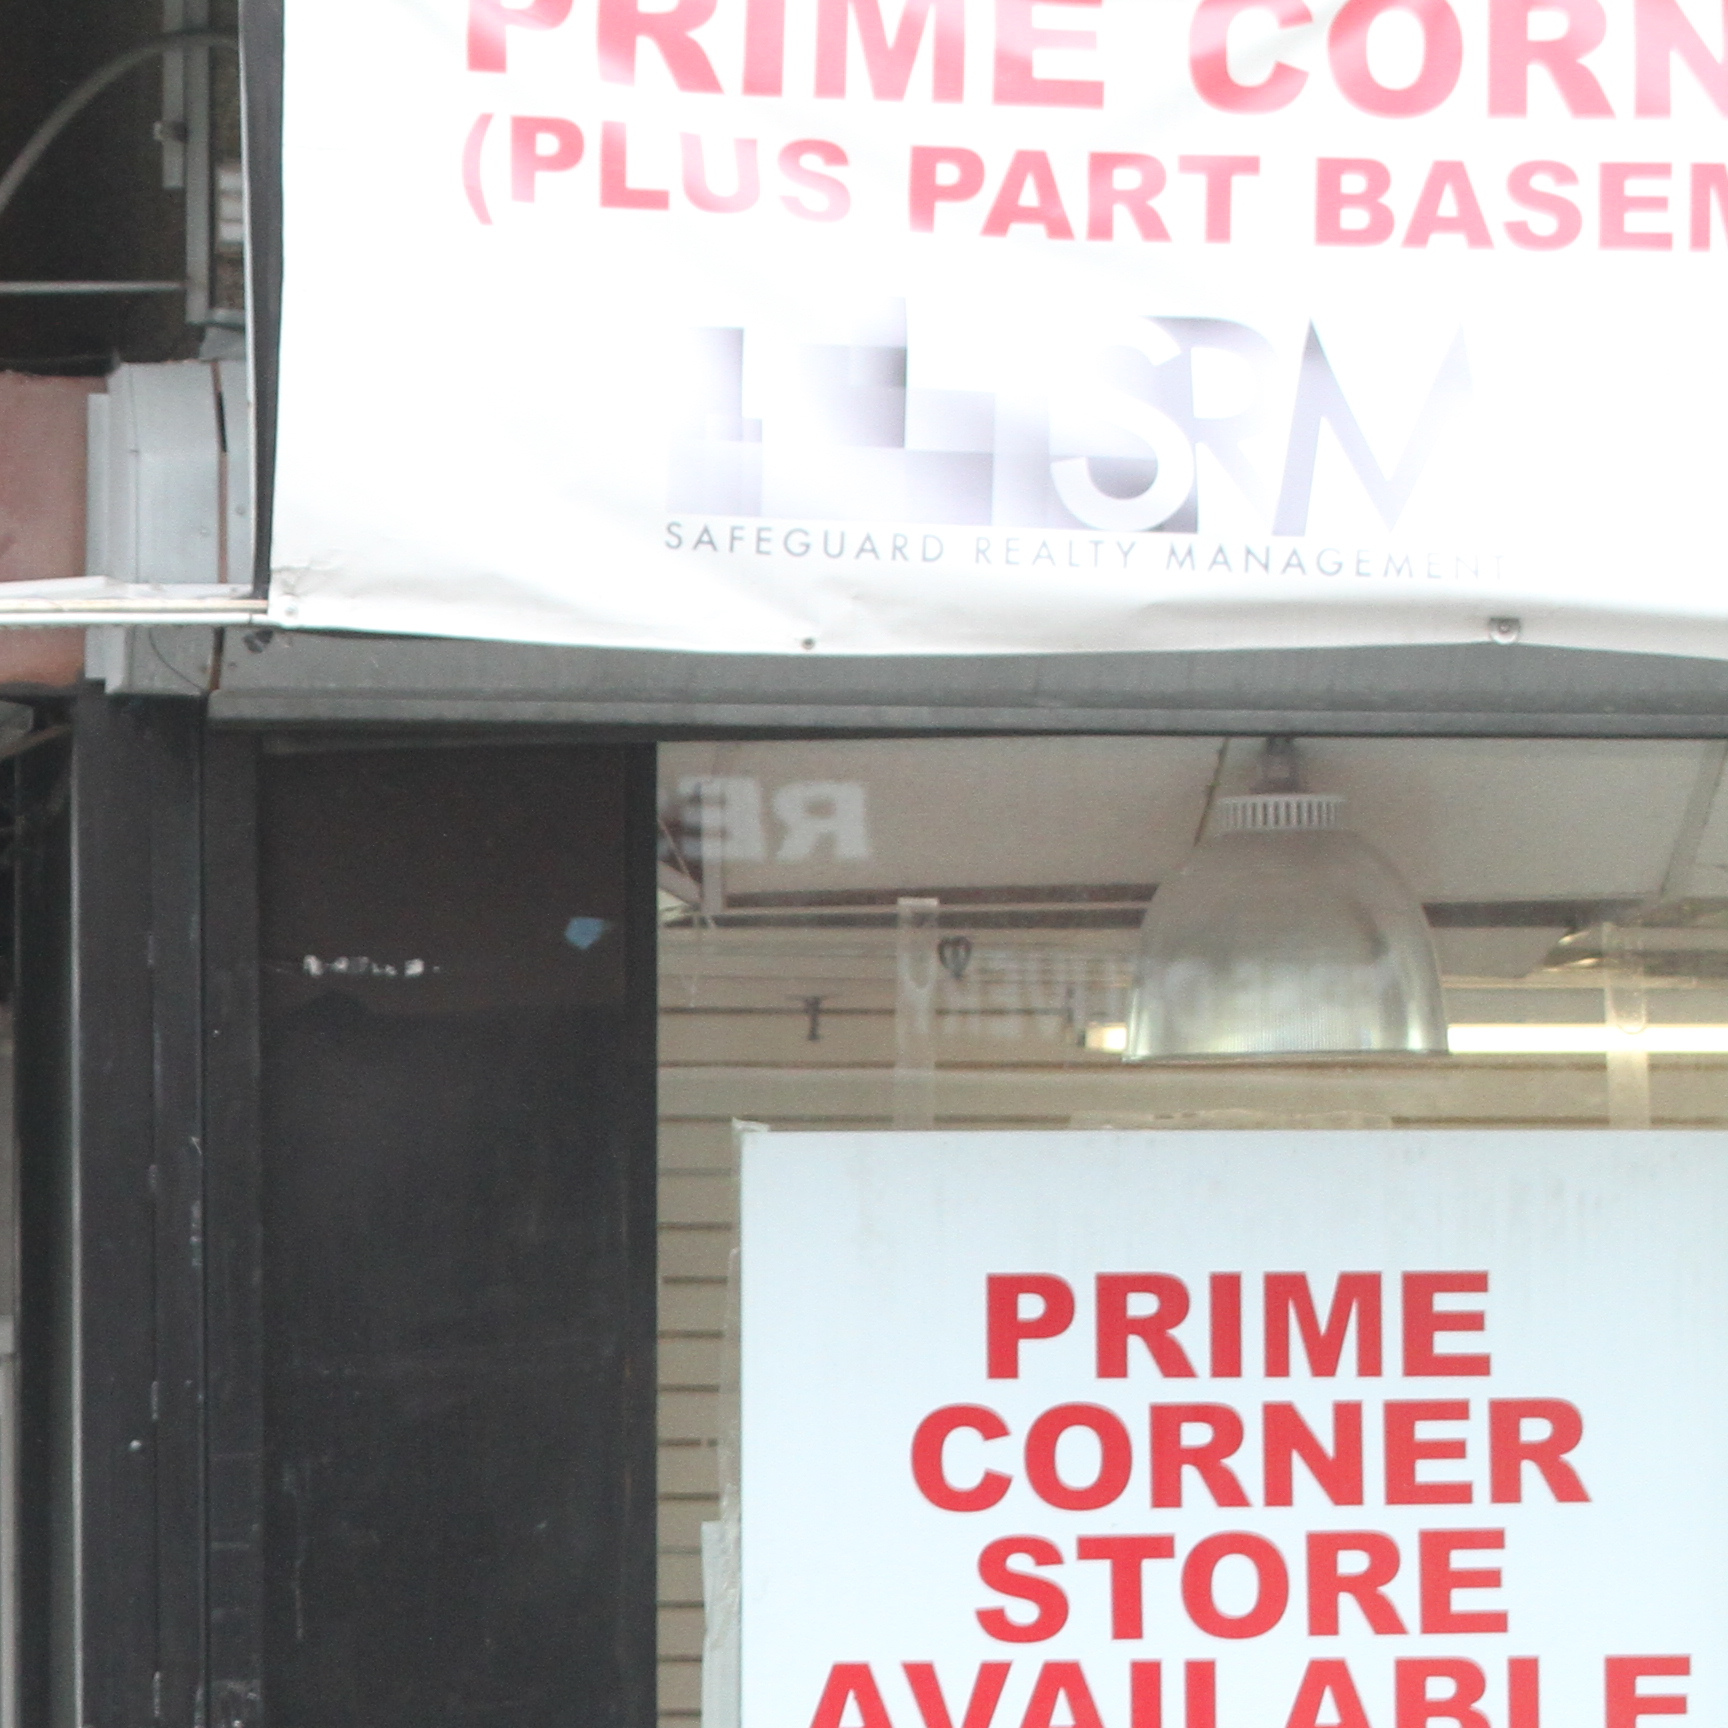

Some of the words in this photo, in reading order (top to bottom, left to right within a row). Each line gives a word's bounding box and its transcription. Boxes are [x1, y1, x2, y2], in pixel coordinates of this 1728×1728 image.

[464, 0, 1107, 108] PRIME
[462, 112, 852, 224] (PLUS
[907, 146, 1261, 246] PART
[663, 519, 948, 567] SAFEGUARD
[974, 533, 1138, 574] REALTY
[1165, 541, 1504, 581] MANAGEMENT
[984, 1270, 1492, 1380] PRIME
[910, 1398, 1591, 1513] CORNER
[976, 1528, 1509, 1643] STORE
